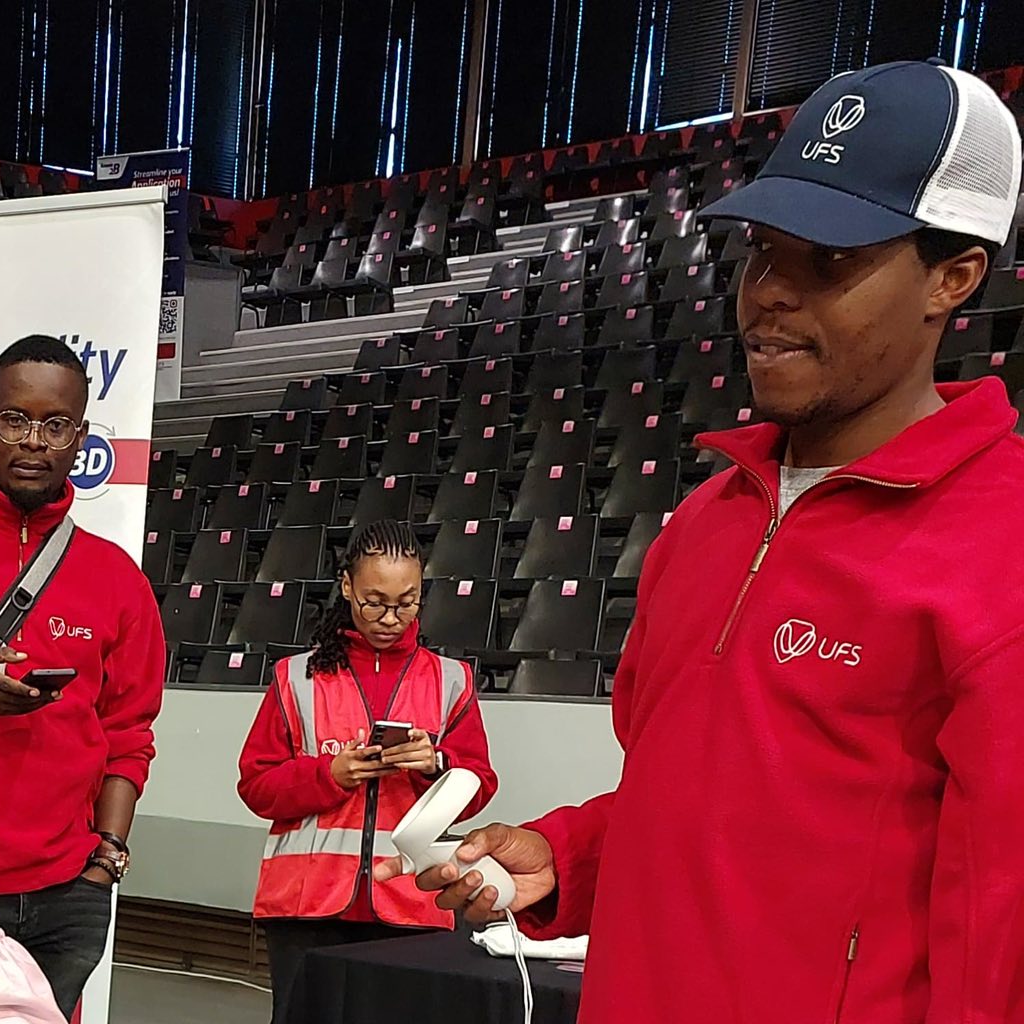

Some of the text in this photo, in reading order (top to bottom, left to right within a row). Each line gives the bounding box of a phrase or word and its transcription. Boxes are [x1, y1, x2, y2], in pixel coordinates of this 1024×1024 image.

[801, 140, 845, 164] UFS
[67, 625, 93, 640] UFS
[818, 637, 862, 666] UFS
